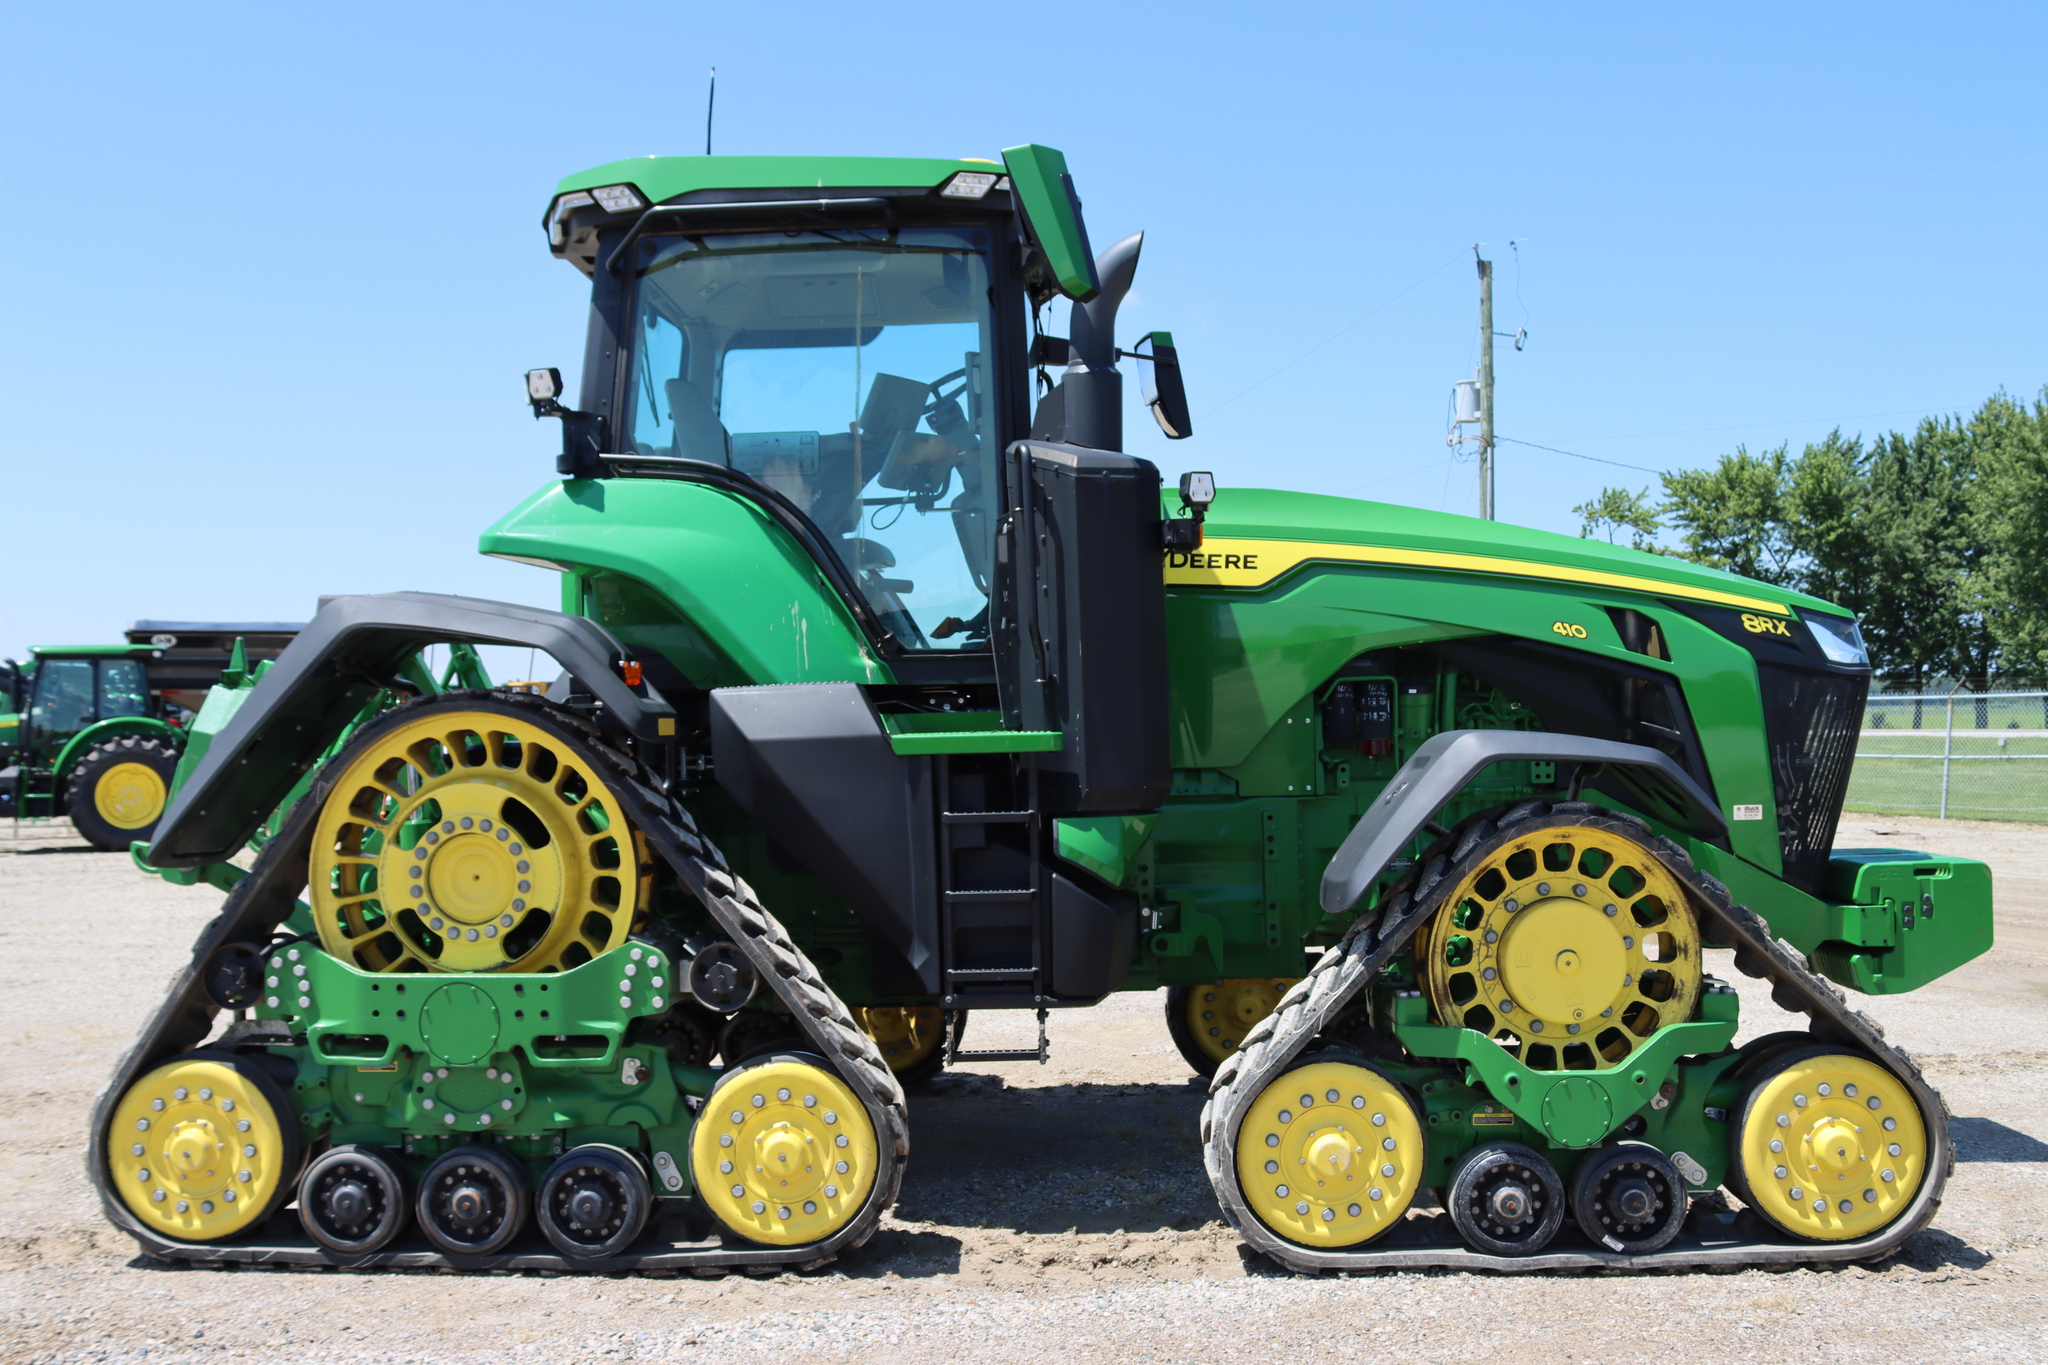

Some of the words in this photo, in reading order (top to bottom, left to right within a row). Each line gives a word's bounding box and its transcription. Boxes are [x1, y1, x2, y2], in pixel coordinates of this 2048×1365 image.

[1169, 552, 1258, 569] DEERE
[1552, 621, 1587, 639] 410
[1741, 613, 1791, 637] 8RX
